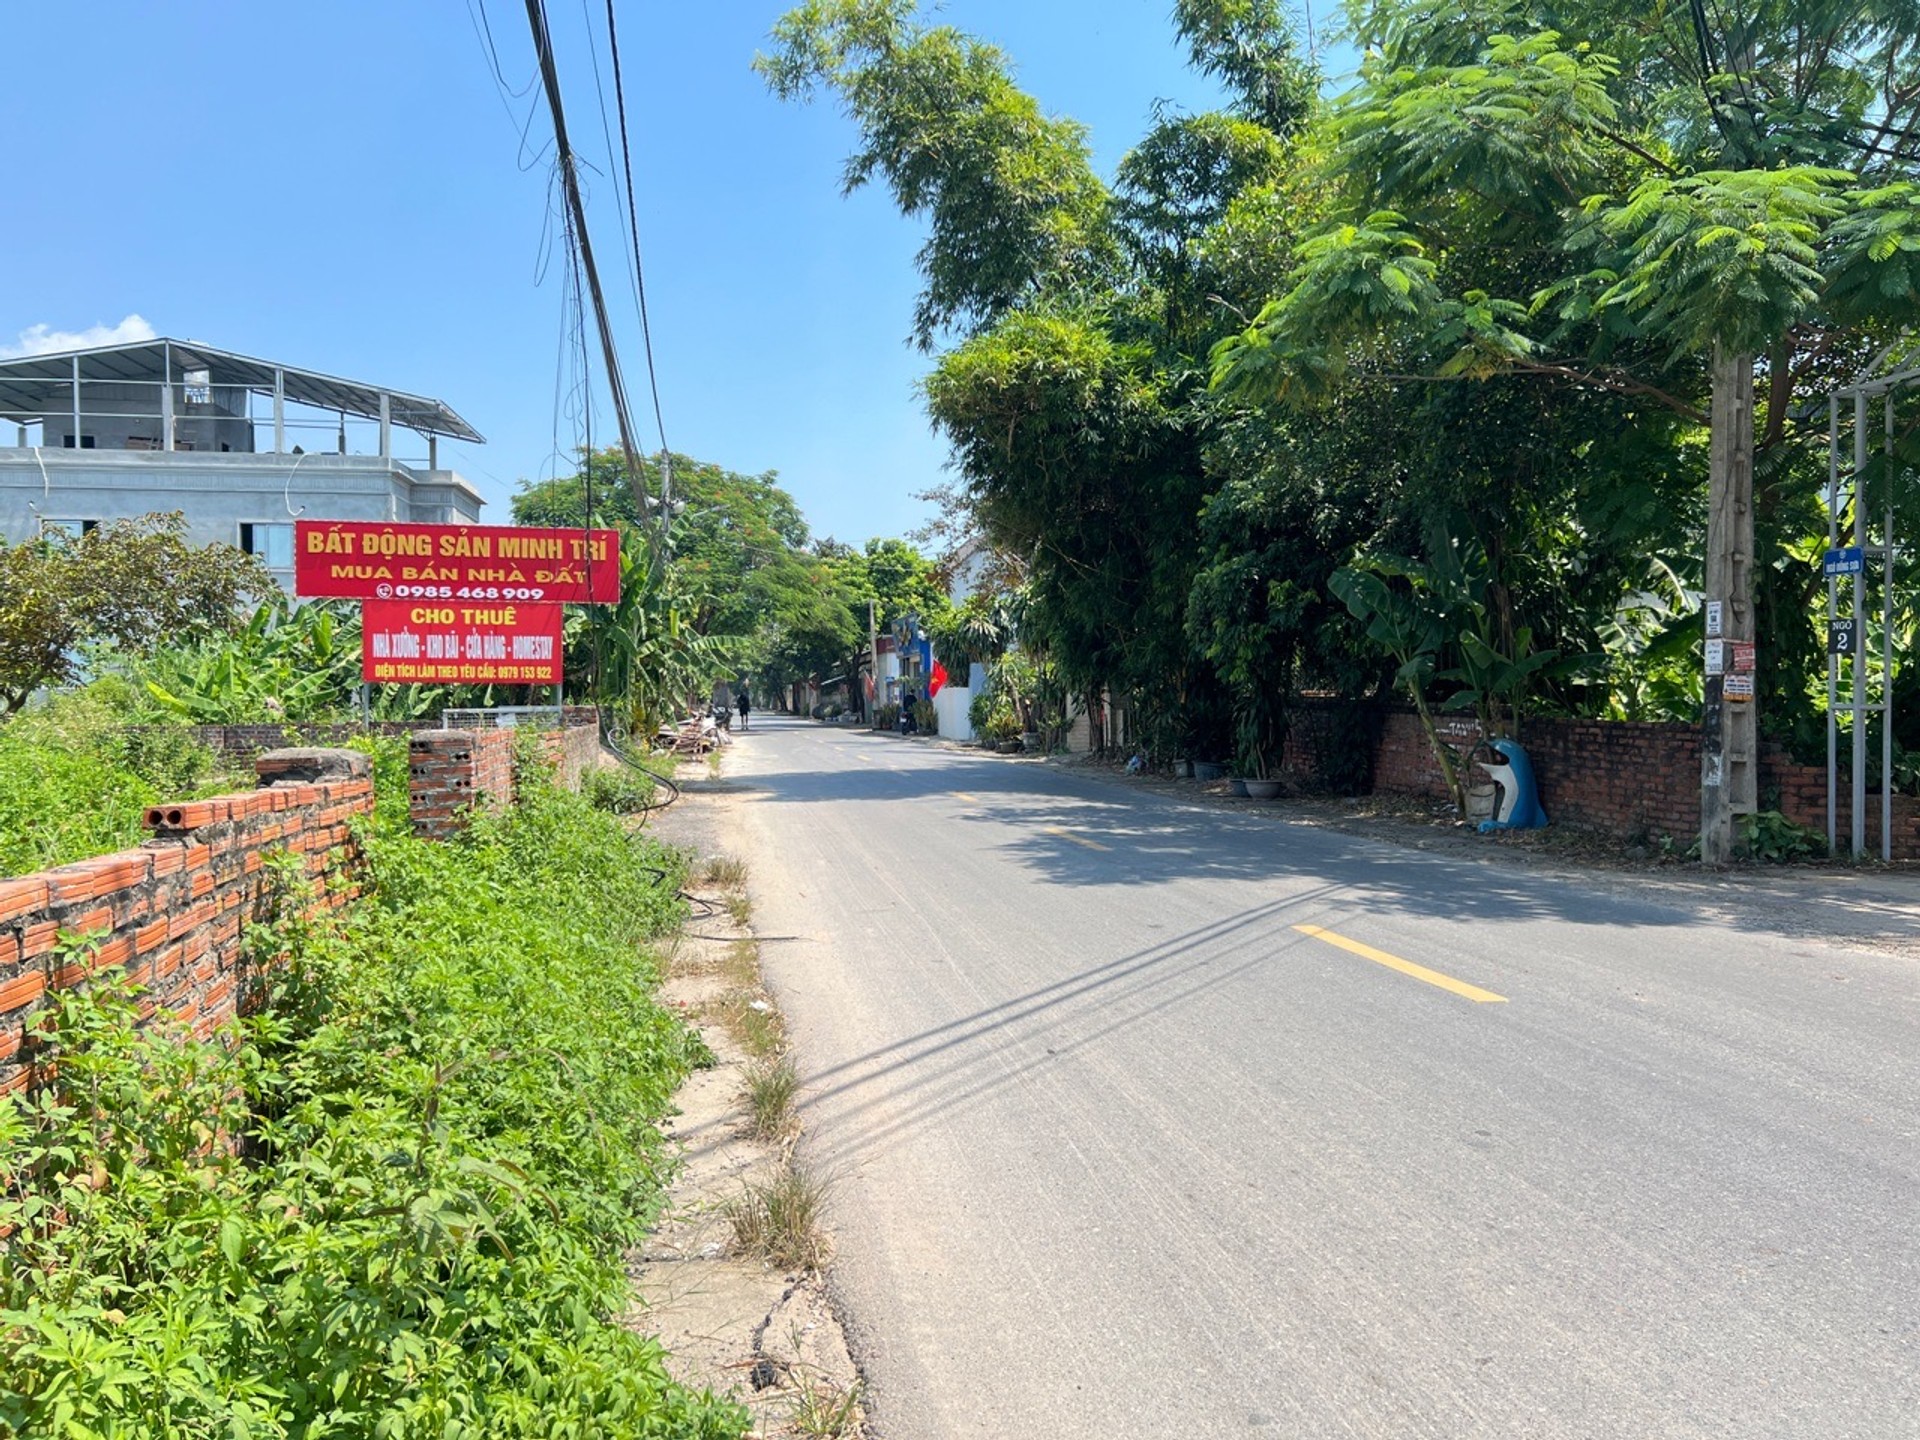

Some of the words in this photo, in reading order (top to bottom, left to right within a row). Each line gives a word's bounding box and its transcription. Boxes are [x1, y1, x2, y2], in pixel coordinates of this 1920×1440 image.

[307, 524, 356, 554] BẤT
[362, 528, 432, 560] ĐỘNG
[439, 528, 490, 558] SẢN
[498, 537, 563, 560] MINH
[570, 534, 608, 561] TRÍ
[331, 565, 393, 579] MUA
[402, 560, 459, 581] BÁN
[468, 562, 527, 583] NHÀ
[534, 562, 587, 584] ĐẤT
[395, 585, 453, 598] 0985
[456, 587, 500, 599] 468
[502, 588, 545, 600] 909
[410, 607, 455, 624] CHO
[460, 605, 517, 625] THUÊ
[512, 635, 553, 660] HOMESTAY
[1837, 632, 1848, 650] 2
[436, 664, 458, 678] THEO
[498, 665, 519, 679] 0979
[520, 665, 535, 679] 153
[536, 666, 552, 679] 922
